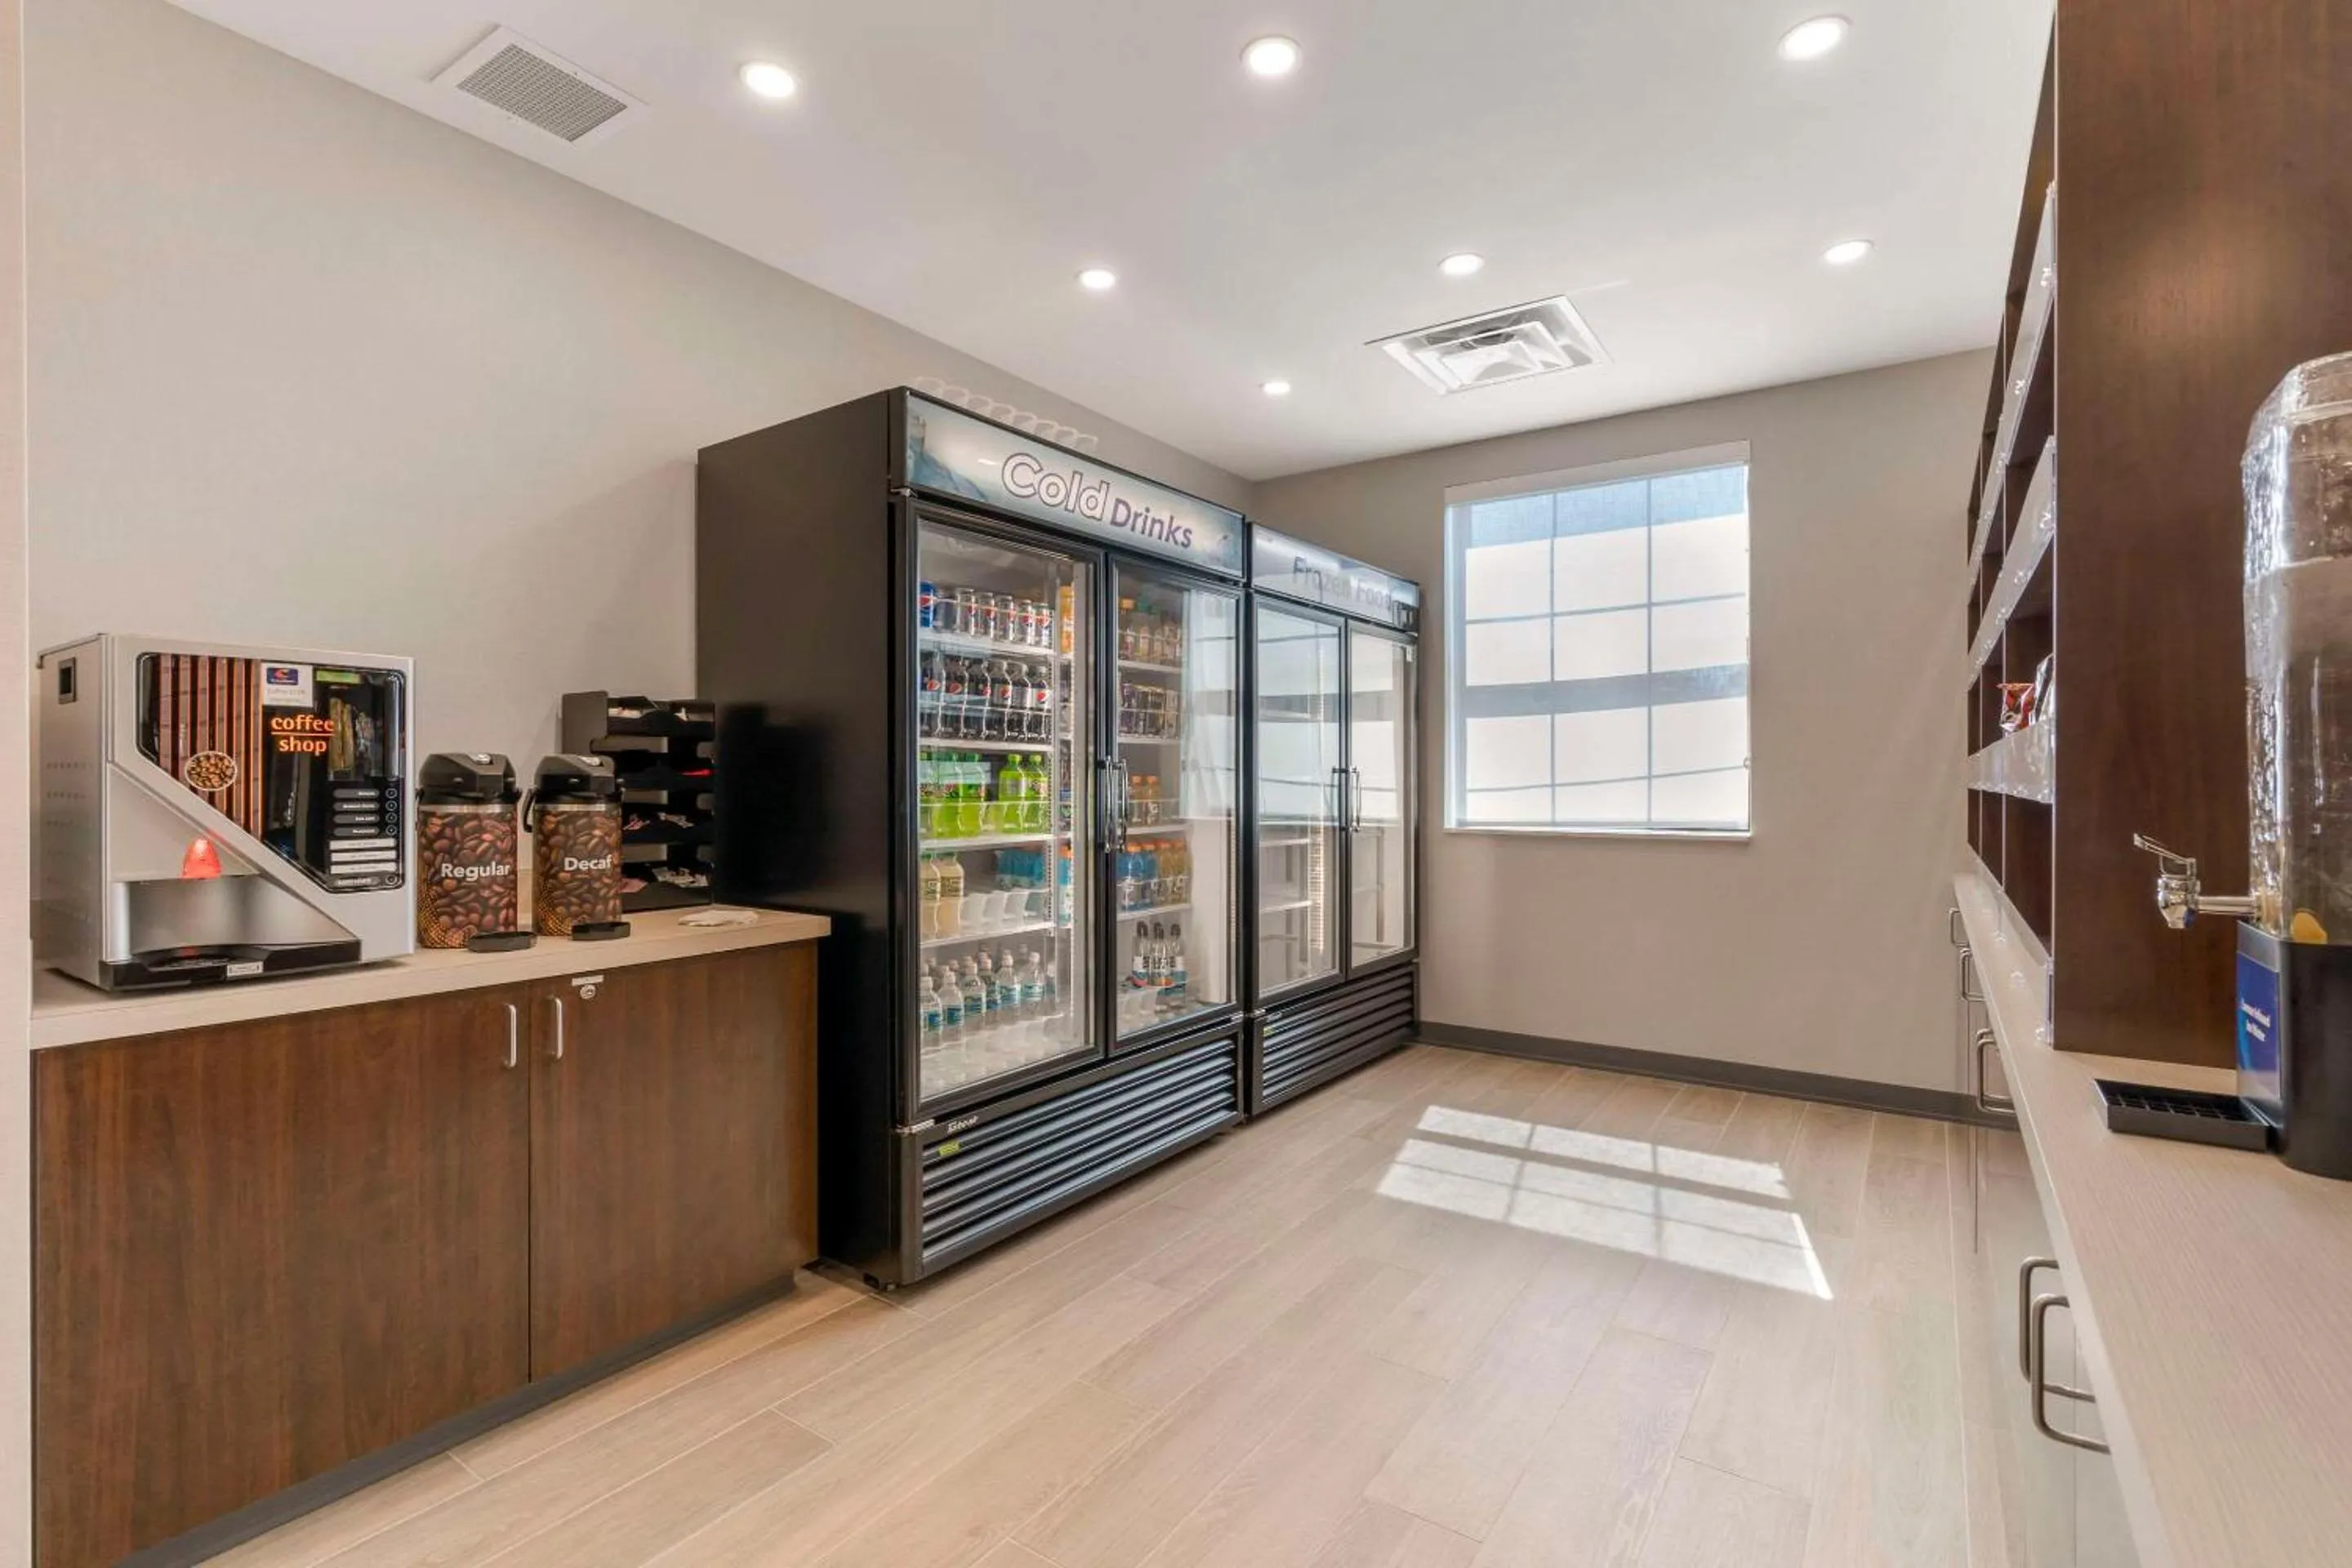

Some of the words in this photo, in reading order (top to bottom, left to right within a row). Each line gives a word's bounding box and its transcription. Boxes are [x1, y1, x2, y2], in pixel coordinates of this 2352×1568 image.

[1001, 452, 1110, 520] Cold
[1110, 498, 1192, 548] Drinks
[271, 715, 334, 732] coffee
[278, 736, 327, 756] shop
[441, 862, 510, 881] Regular
[564, 854, 612, 871] Decaf
